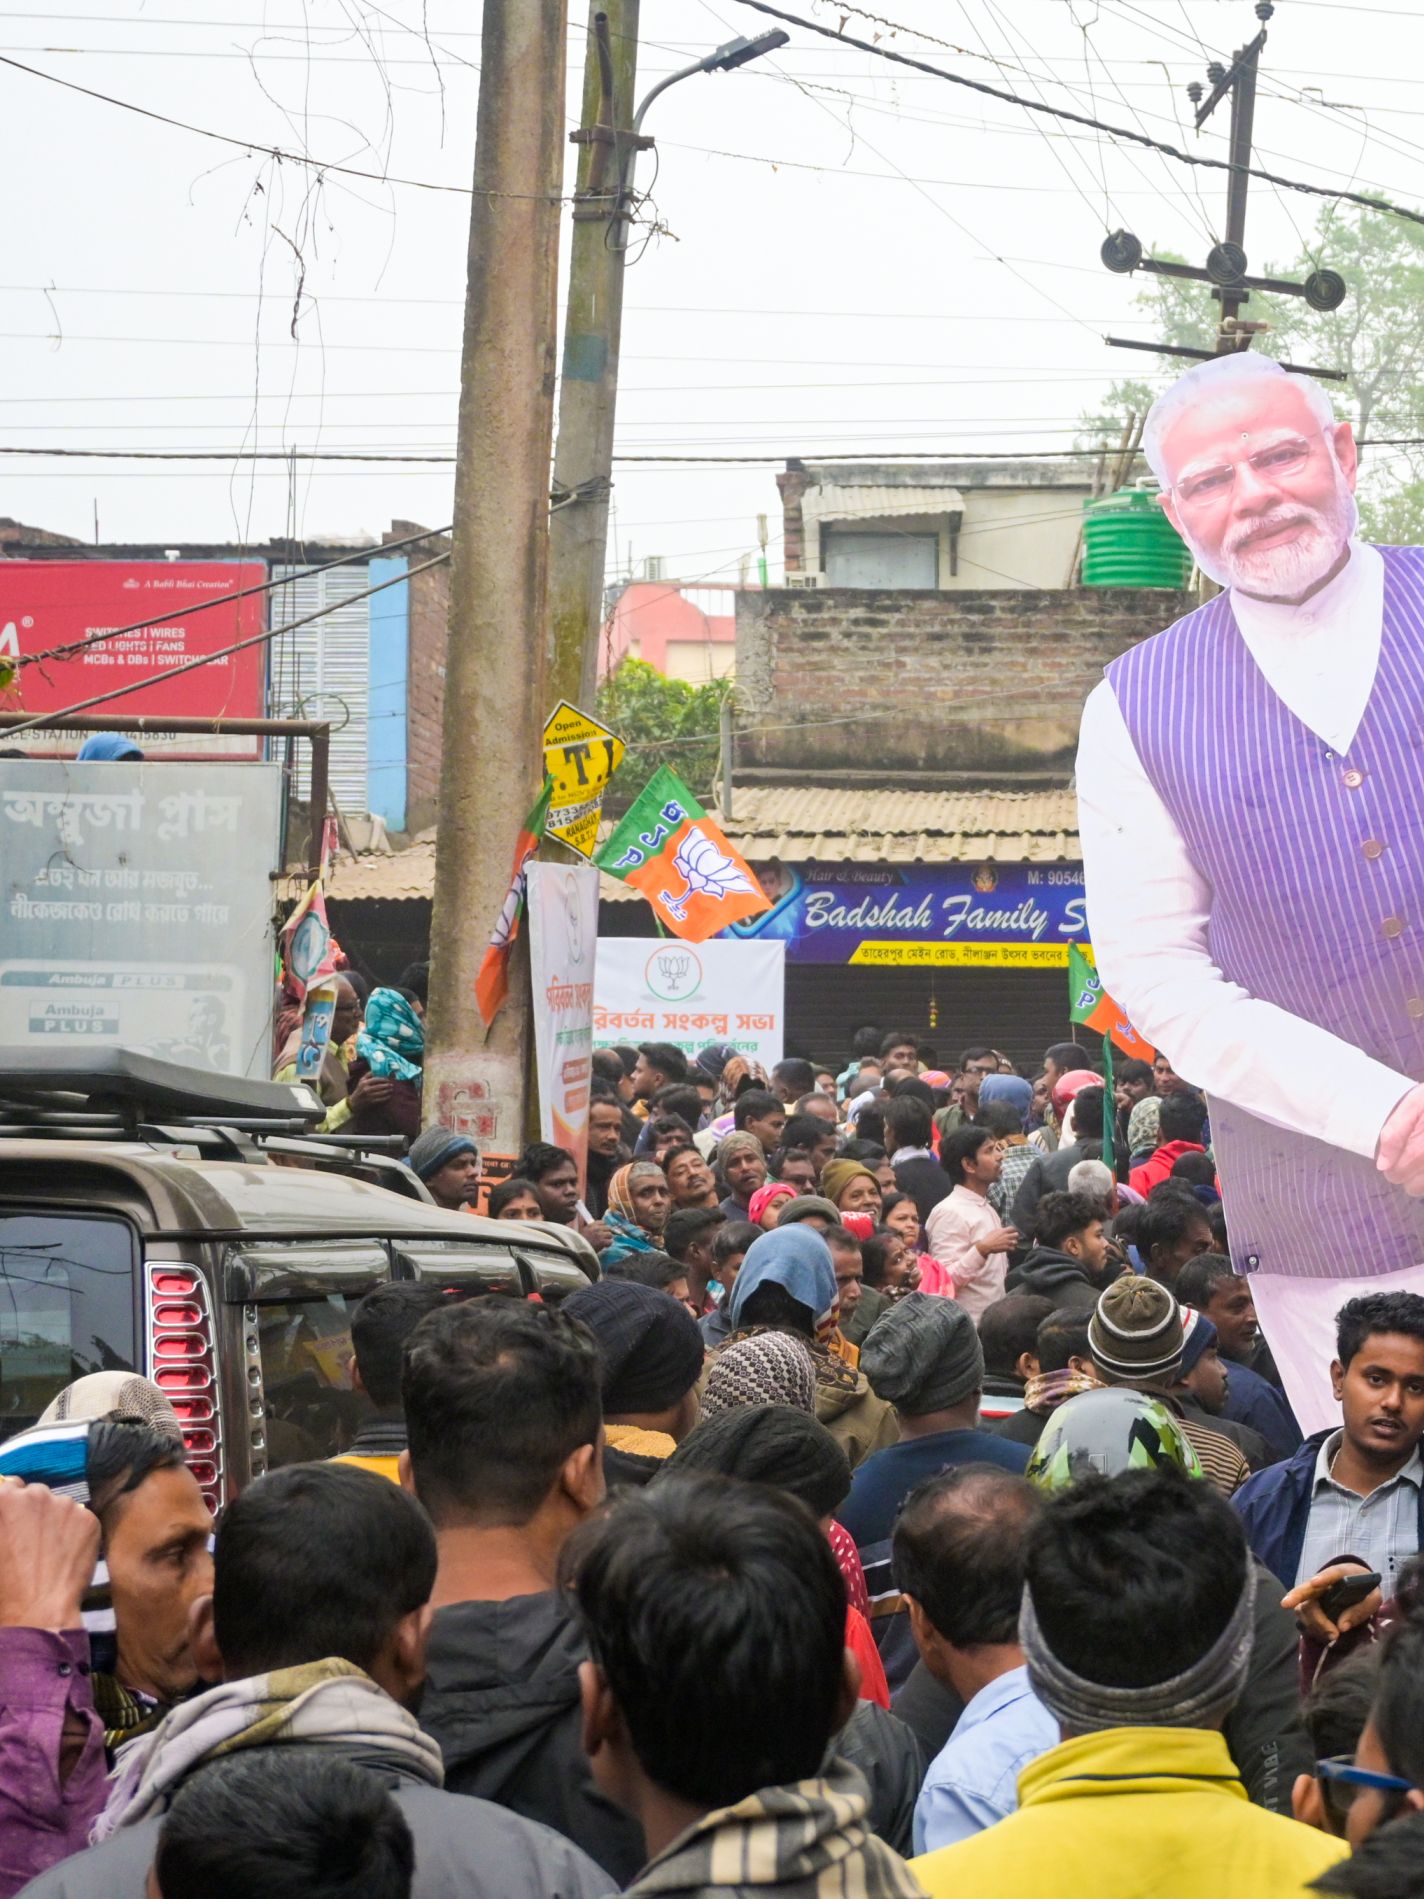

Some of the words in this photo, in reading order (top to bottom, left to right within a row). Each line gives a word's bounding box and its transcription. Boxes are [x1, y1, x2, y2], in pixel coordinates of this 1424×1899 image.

[150, 627, 186, 639] WIRES
[109, 640, 147, 651] LIGHTS
[156, 640, 185, 651] FANS
[84, 654, 115, 665] MCBs
[117, 654, 125, 665] &
[127, 654, 149, 665] DBs
[555, 721, 582, 732] Open
[545, 731, 597, 746] Admission
[805, 869, 836, 881] Hair
[851, 870, 894, 886] Beauty
[1028, 871, 1043, 884] M:
[1047, 871, 1086, 885] 90546
[805, 891, 934, 928] Badshah
[942, 894, 1048, 940] Family
[49, 974, 106, 987] Ambuja
[45, 1004, 104, 1018] Ambuja
[44, 1020, 104, 1032] PLUS
[592, 1004, 655, 1030] রিবর্তন
[662, 1013, 729, 1035] সংকল্প
[736, 1013, 775, 1030] সভা
